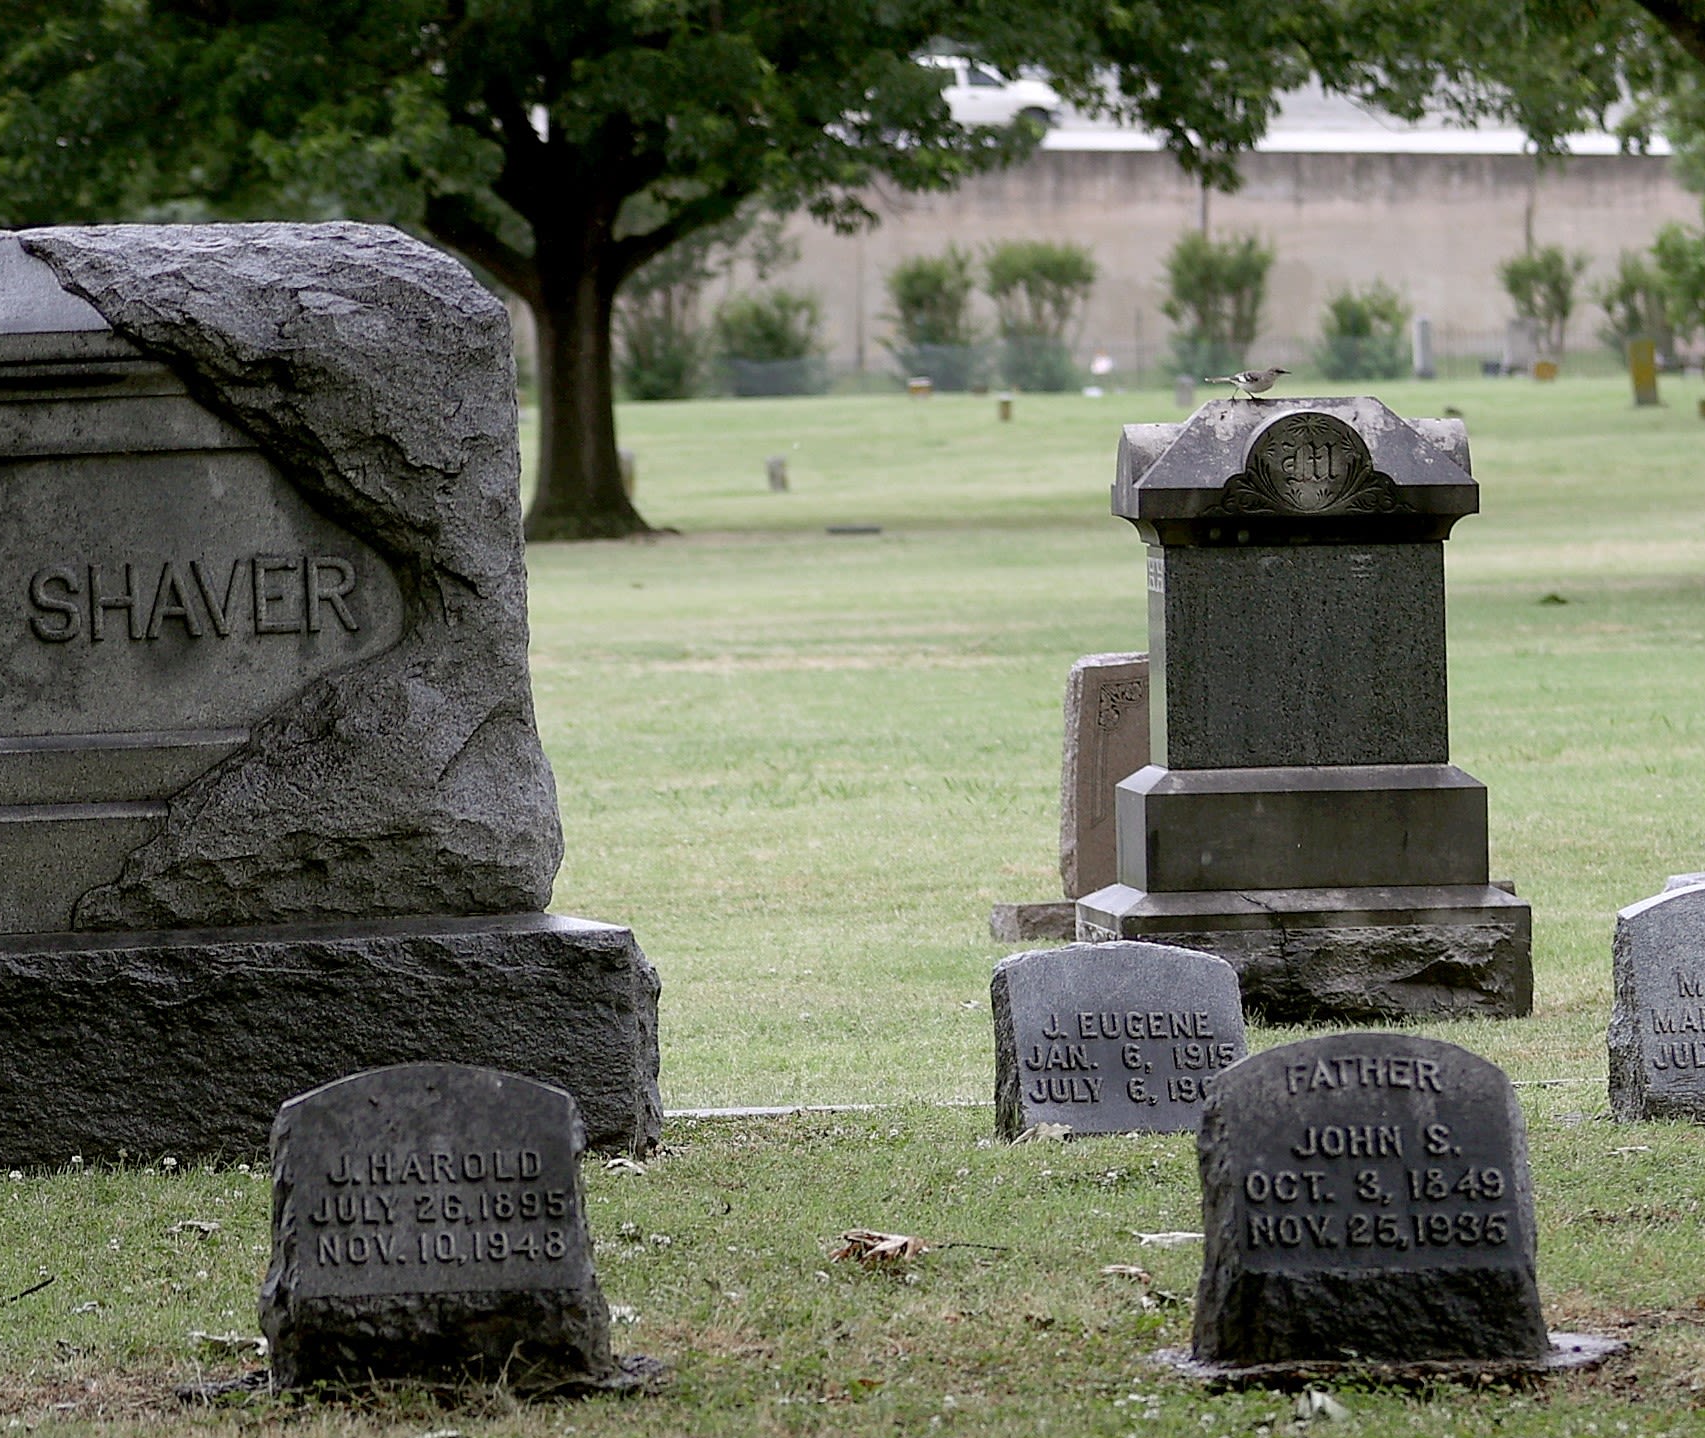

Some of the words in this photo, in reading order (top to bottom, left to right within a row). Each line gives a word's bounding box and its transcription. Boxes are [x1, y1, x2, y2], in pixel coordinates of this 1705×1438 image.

[29, 554, 360, 643] SHAVER
[1078, 1010, 1214, 1040] EUGENE
[1026, 1043, 1099, 1071] JAN.
[1122, 1043, 1153, 1074] 6,
[1173, 1043, 1235, 1070] 1915
[1029, 1077, 1104, 1104] JULY
[1286, 1056, 1442, 1096] FATHER
[1292, 1124, 1403, 1157] JOHN
[1426, 1123, 1463, 1156] S.
[1246, 1170, 1334, 1202] OCT.
[1409, 1166, 1506, 1200] 1849
[309, 1193, 399, 1226] JULY
